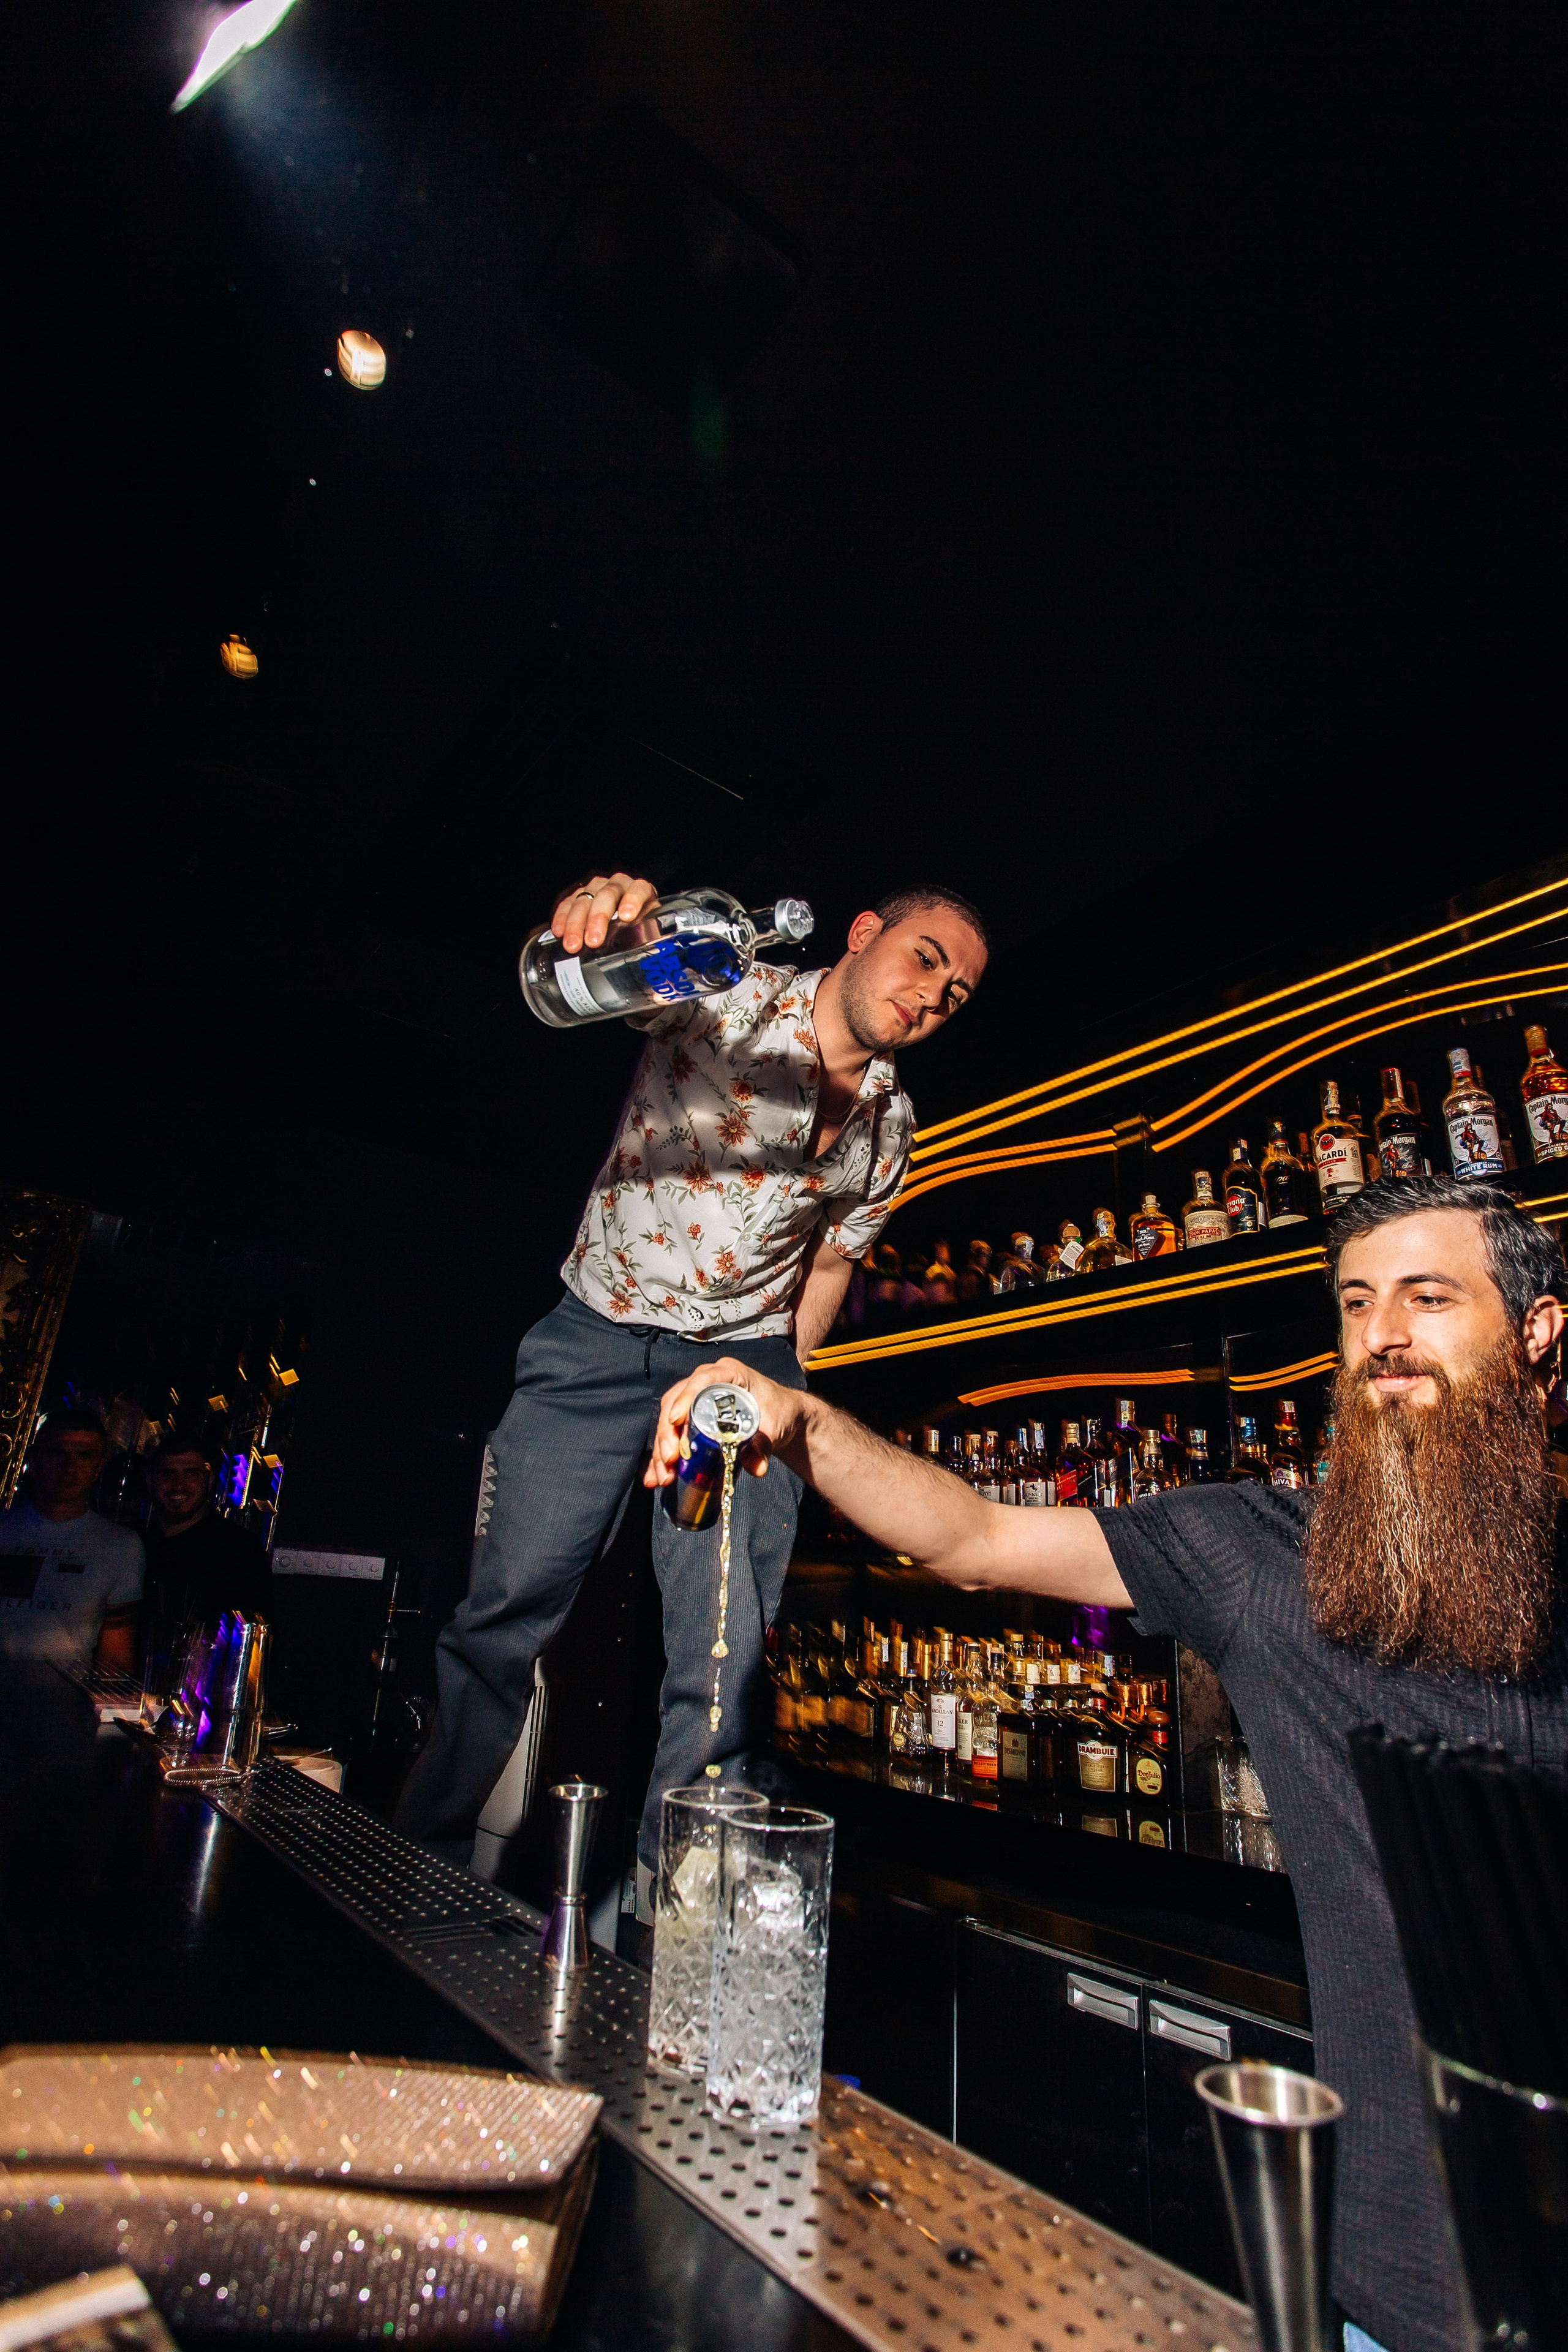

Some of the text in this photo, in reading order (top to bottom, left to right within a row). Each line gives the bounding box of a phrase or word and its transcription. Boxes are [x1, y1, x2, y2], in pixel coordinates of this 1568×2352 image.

[1528, 1096, 1568, 1114] Captain Morg
[1450, 1117, 1493, 1134] Captain Morgan
[1391, 1136, 1416, 1145] Morgan
[1540, 1146, 1562, 1156] SPICED
[1461, 1163, 1482, 1174] WHITE
[1226, 1197, 1246, 1209] avana
[1227, 1205, 1240, 1215] Club
[14, 1545, 76, 1556] TOMMY
[0, 1597, 73, 1611] LFIGER
[1079, 1744, 1115, 1756] DRAMBUIE
